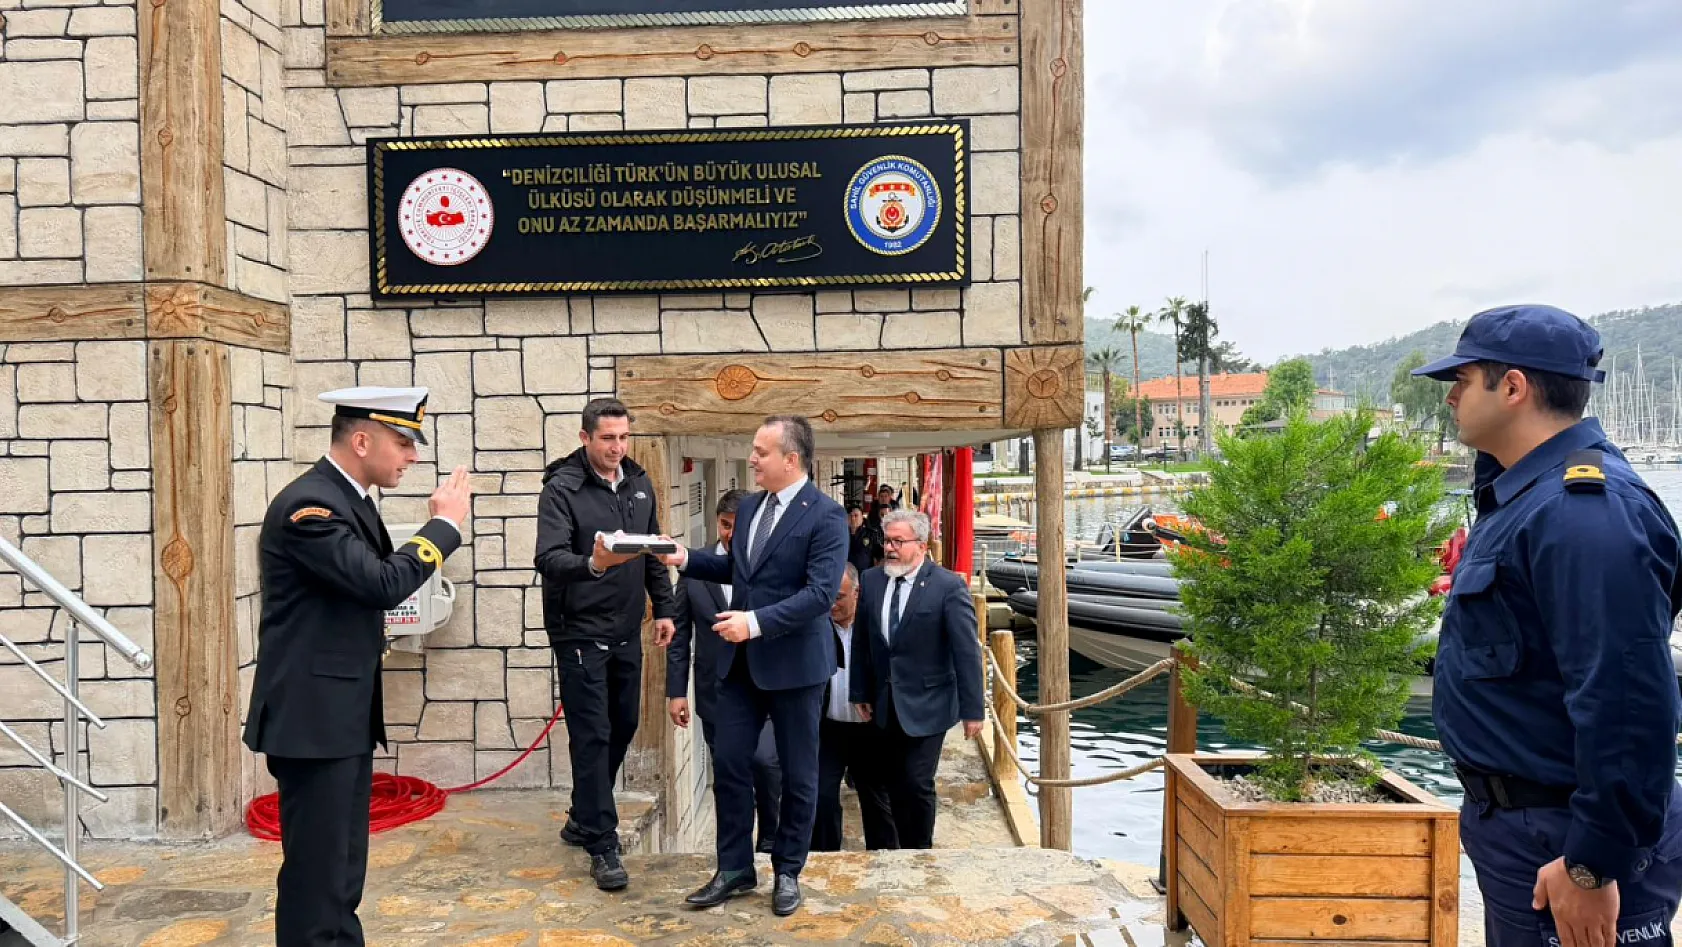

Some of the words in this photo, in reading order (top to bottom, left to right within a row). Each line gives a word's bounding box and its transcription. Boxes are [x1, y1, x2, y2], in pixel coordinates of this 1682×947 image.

[613, 161, 689, 183] TÜRK’ÜN
[694, 160, 752, 181] BÜYÜK
[756, 161, 822, 179] ULUSAL
[528, 188, 595, 209] ÜLKÜSÜ
[600, 190, 668, 208] OLARAK
[672, 184, 771, 208] DÜŞÜNMELİ
[774, 187, 797, 204] VE
[518, 216, 555, 234] ONU
[558, 216, 581, 232] AZ
[585, 214, 670, 233] ZAMANDA
[673, 210, 808, 233] BAŞARMALIYIZ”
[1616, 921, 1666, 944] VENLİK
